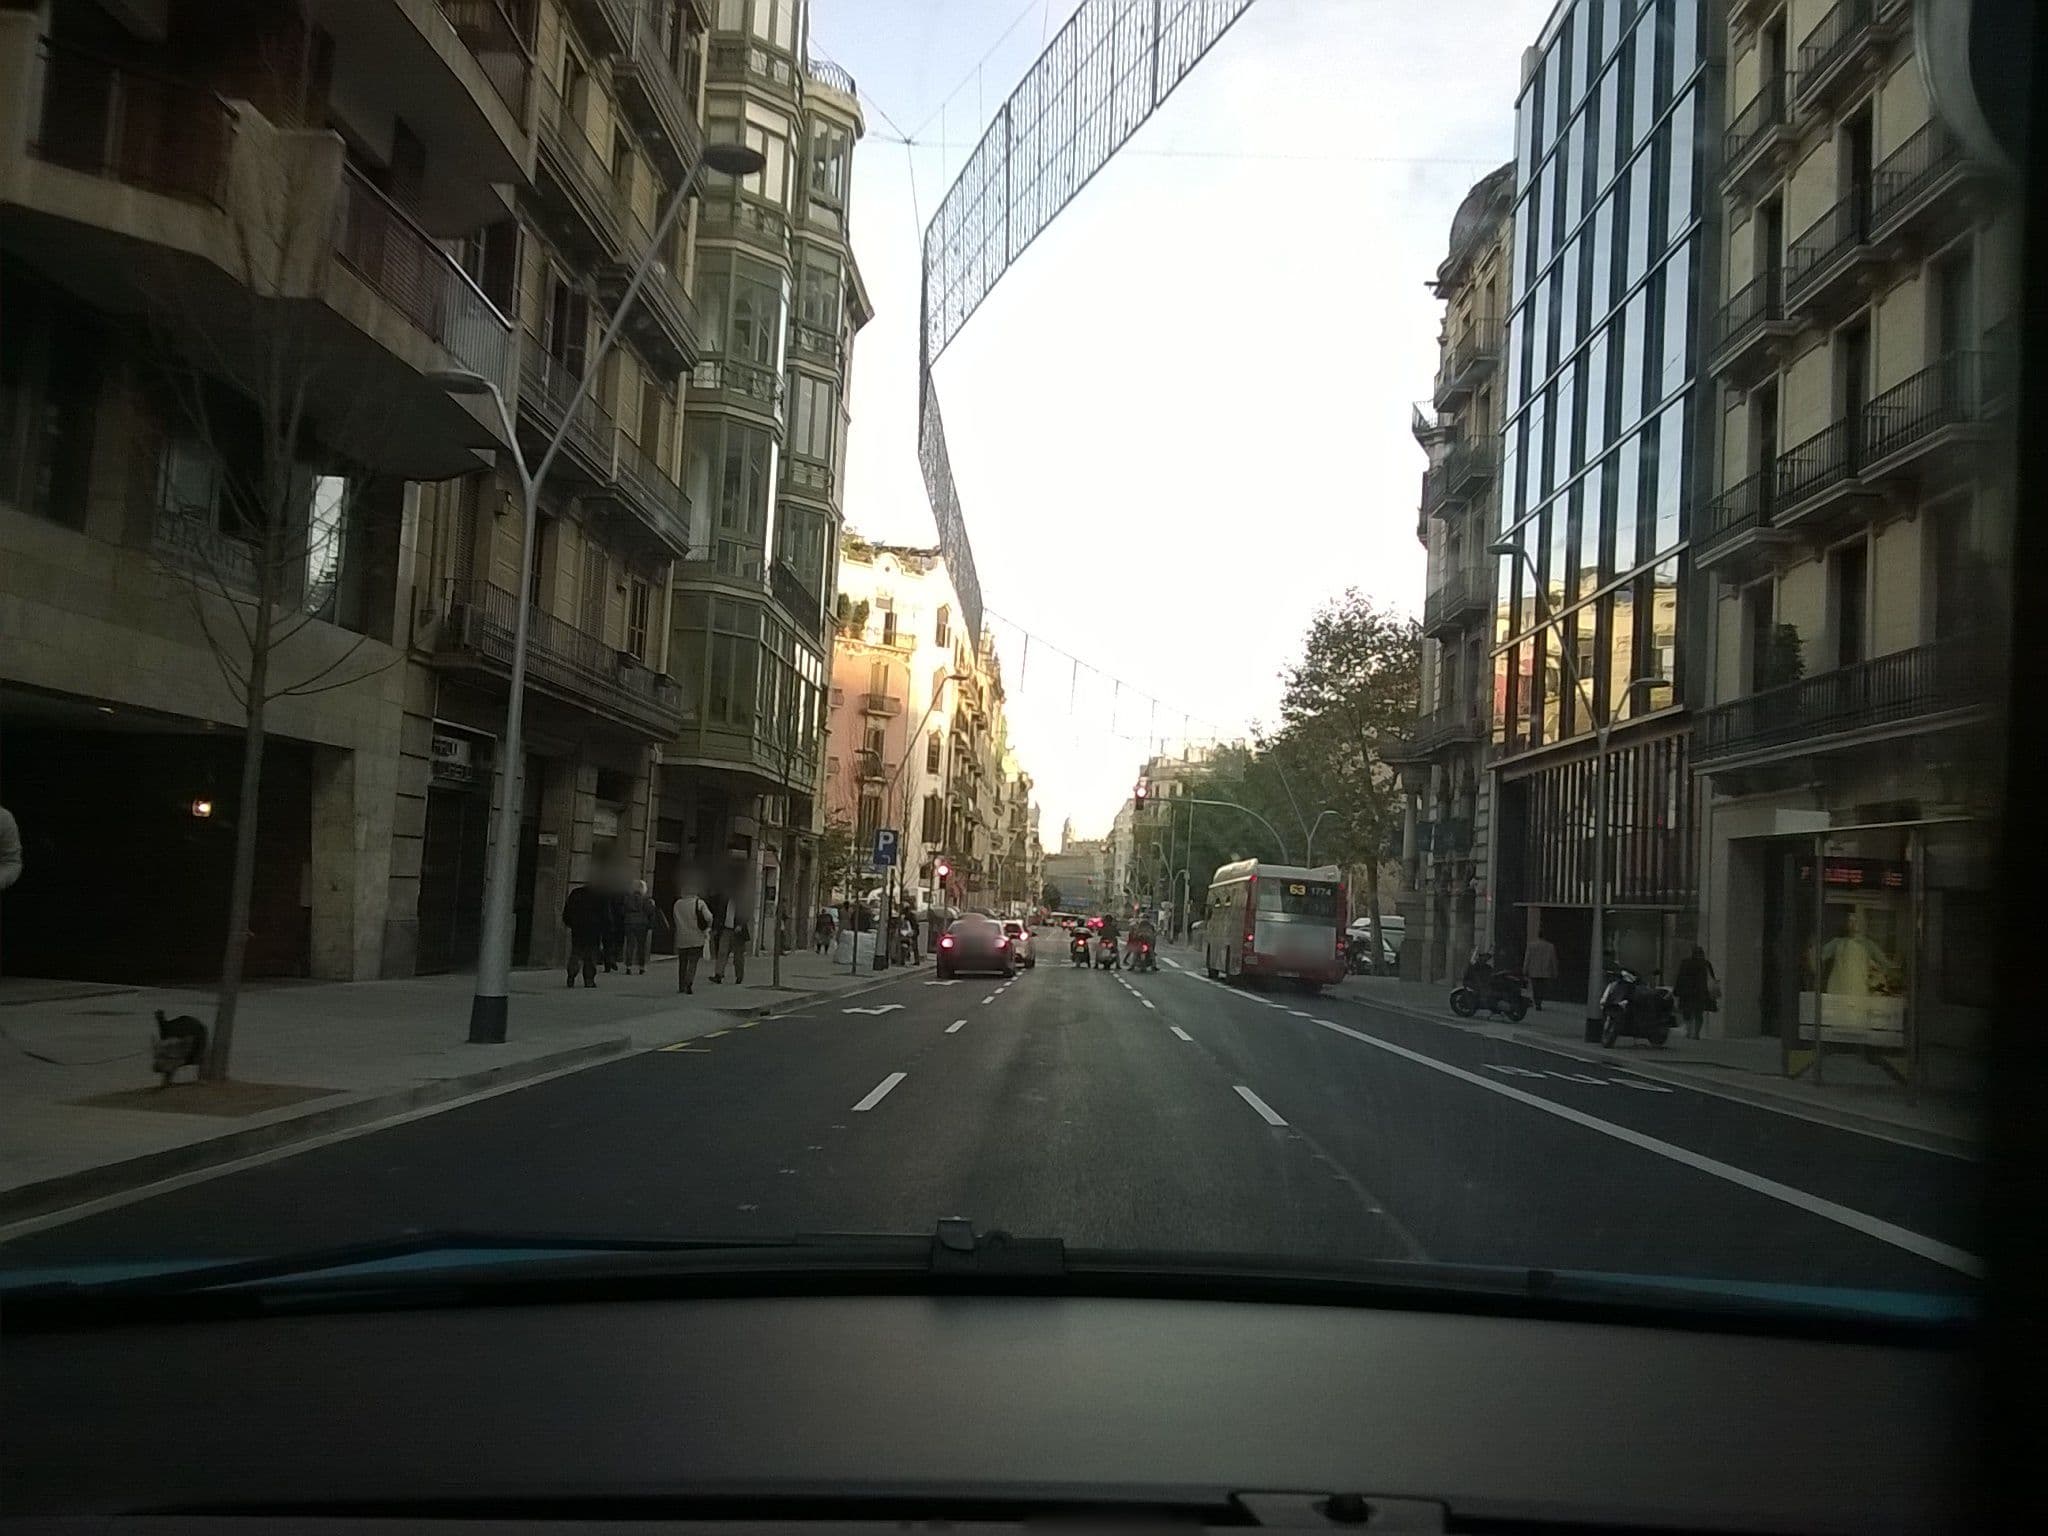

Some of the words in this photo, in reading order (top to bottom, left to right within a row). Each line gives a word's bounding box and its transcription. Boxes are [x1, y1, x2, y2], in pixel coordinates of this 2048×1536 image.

[878, 831, 894, 851] P
[1289, 884, 1306, 896] 63
[1483, 1063, 1674, 1094] BUS
